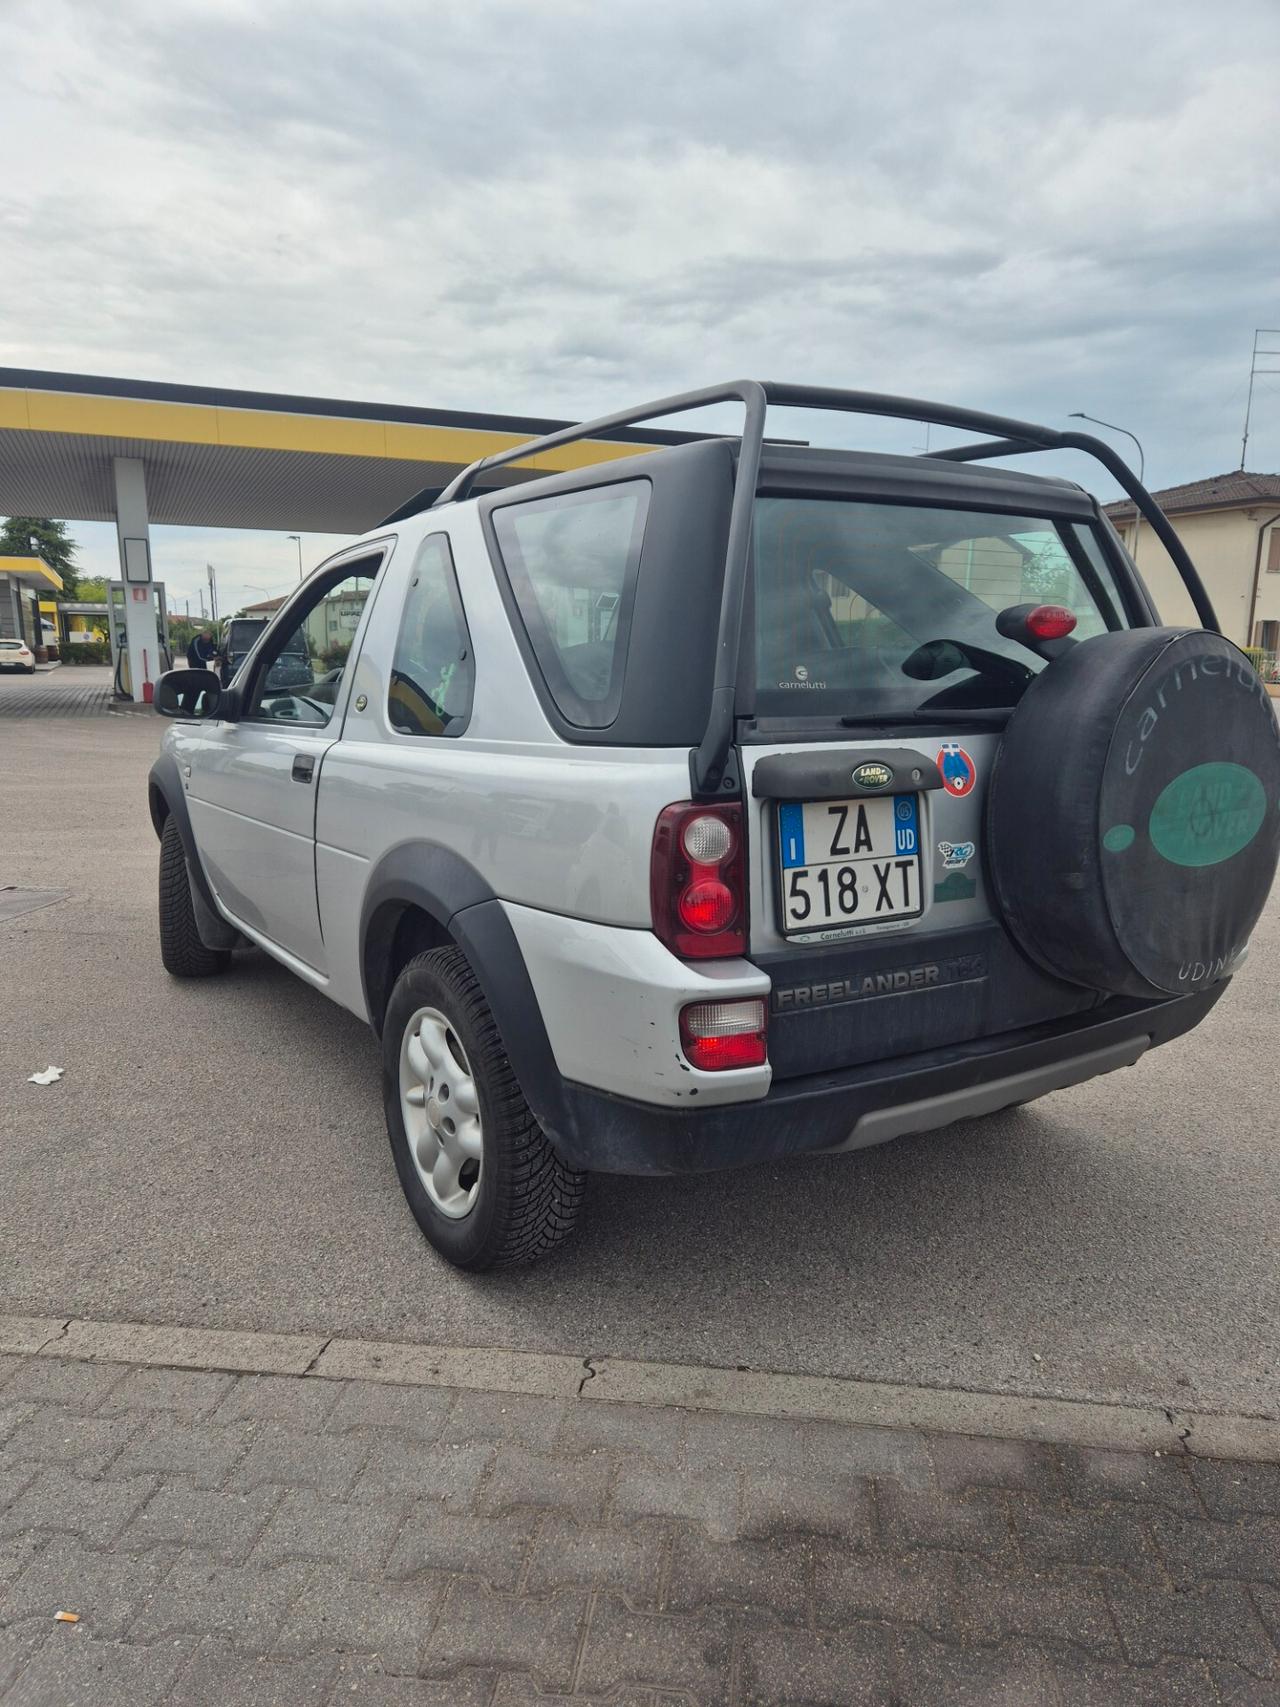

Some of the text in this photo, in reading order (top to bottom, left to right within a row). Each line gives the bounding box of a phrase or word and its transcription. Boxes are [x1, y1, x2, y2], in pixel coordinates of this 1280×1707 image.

[778, 680, 827, 690] carnelutti
[860, 767, 881, 777] LAND
[863, 774, 889, 785] ROVER
[827, 803, 874, 857] ZA
[896, 828, 915, 851] UD
[789, 859, 915, 921] 518 XT
[776, 965, 940, 1009] FREELANDER
